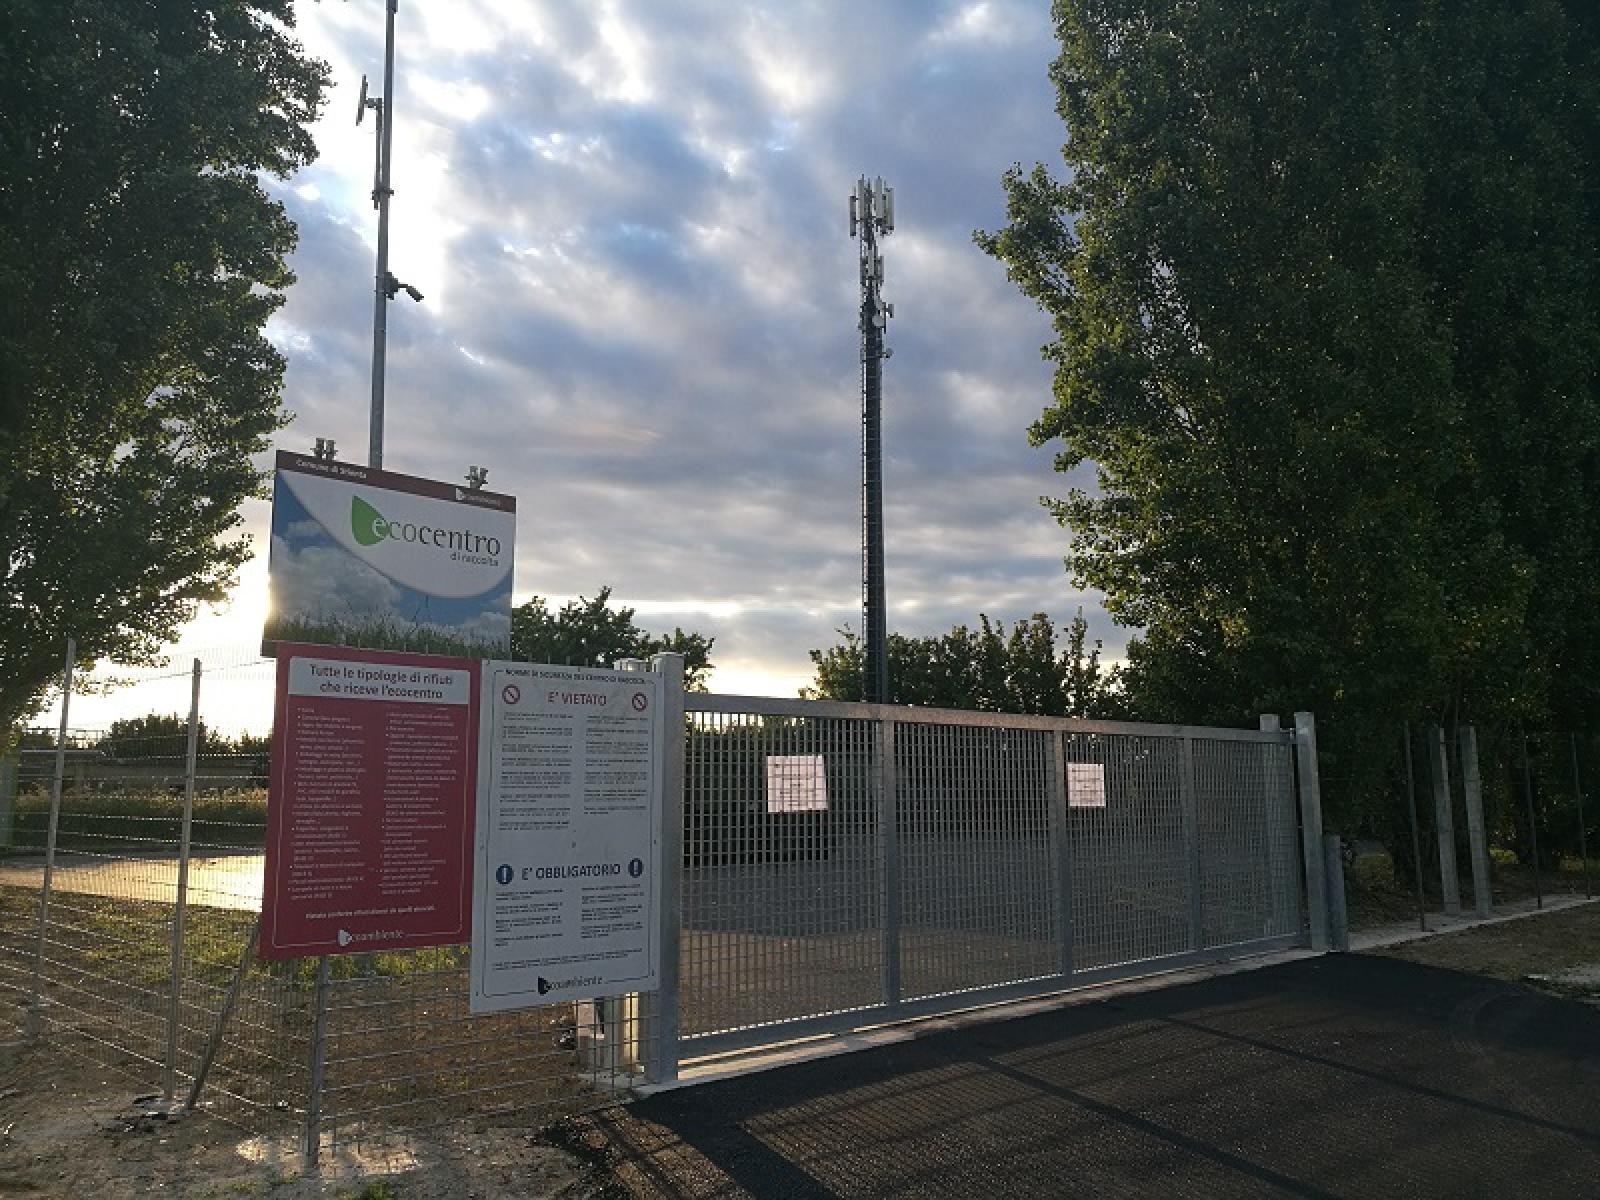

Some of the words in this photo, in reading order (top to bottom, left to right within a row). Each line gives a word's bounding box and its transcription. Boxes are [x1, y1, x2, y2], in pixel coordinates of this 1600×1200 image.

[372, 516, 501, 556] ecocentro
[450, 551, 461, 561] di
[462, 555, 499, 567] raccolta
[310, 663, 340, 677] Tutte
[344, 667, 355, 678] le
[358, 668, 407, 684] tipologie
[410, 671, 420, 683] di
[423, 672, 453, 685] rifiuti
[320, 682, 340, 693] che
[344, 682, 378, 695] riceve
[382, 684, 443, 699] l'ecocentro
[548, 691, 559, 703] E'
[562, 693, 607, 707] VIETATO
[522, 867, 533, 880] E'
[536, 863, 621, 879] OBBLIGATORIO
